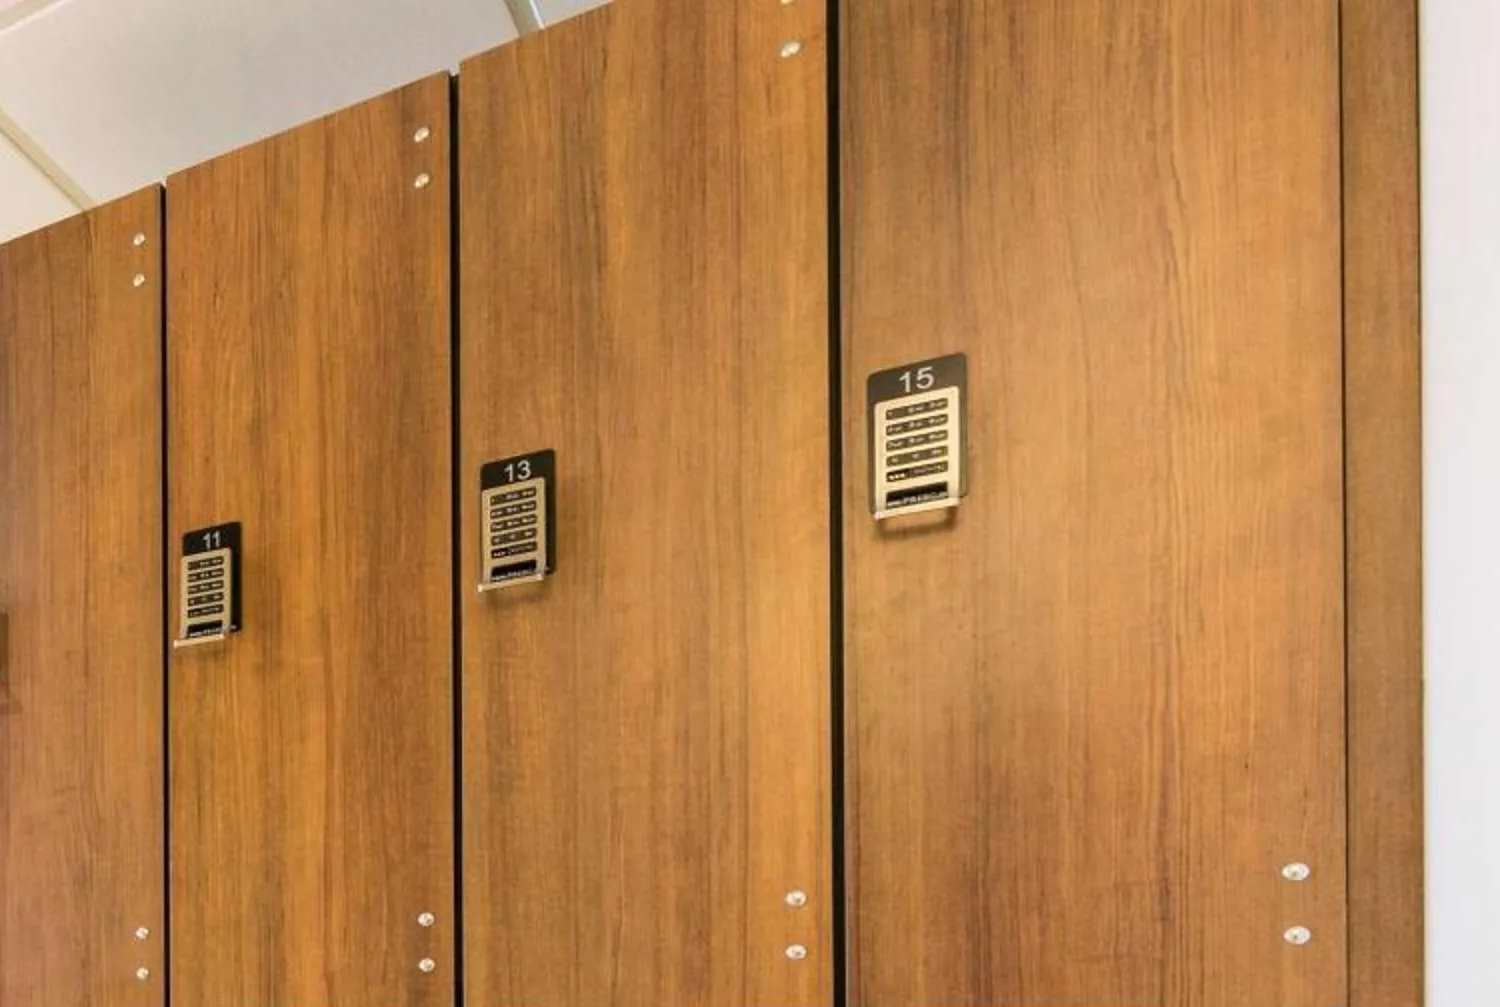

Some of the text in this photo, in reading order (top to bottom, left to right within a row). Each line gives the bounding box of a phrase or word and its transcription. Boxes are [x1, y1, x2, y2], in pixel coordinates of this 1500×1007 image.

[900, 366, 935, 393] 15
[504, 460, 531, 482] 13
[203, 530, 221, 550] 11
